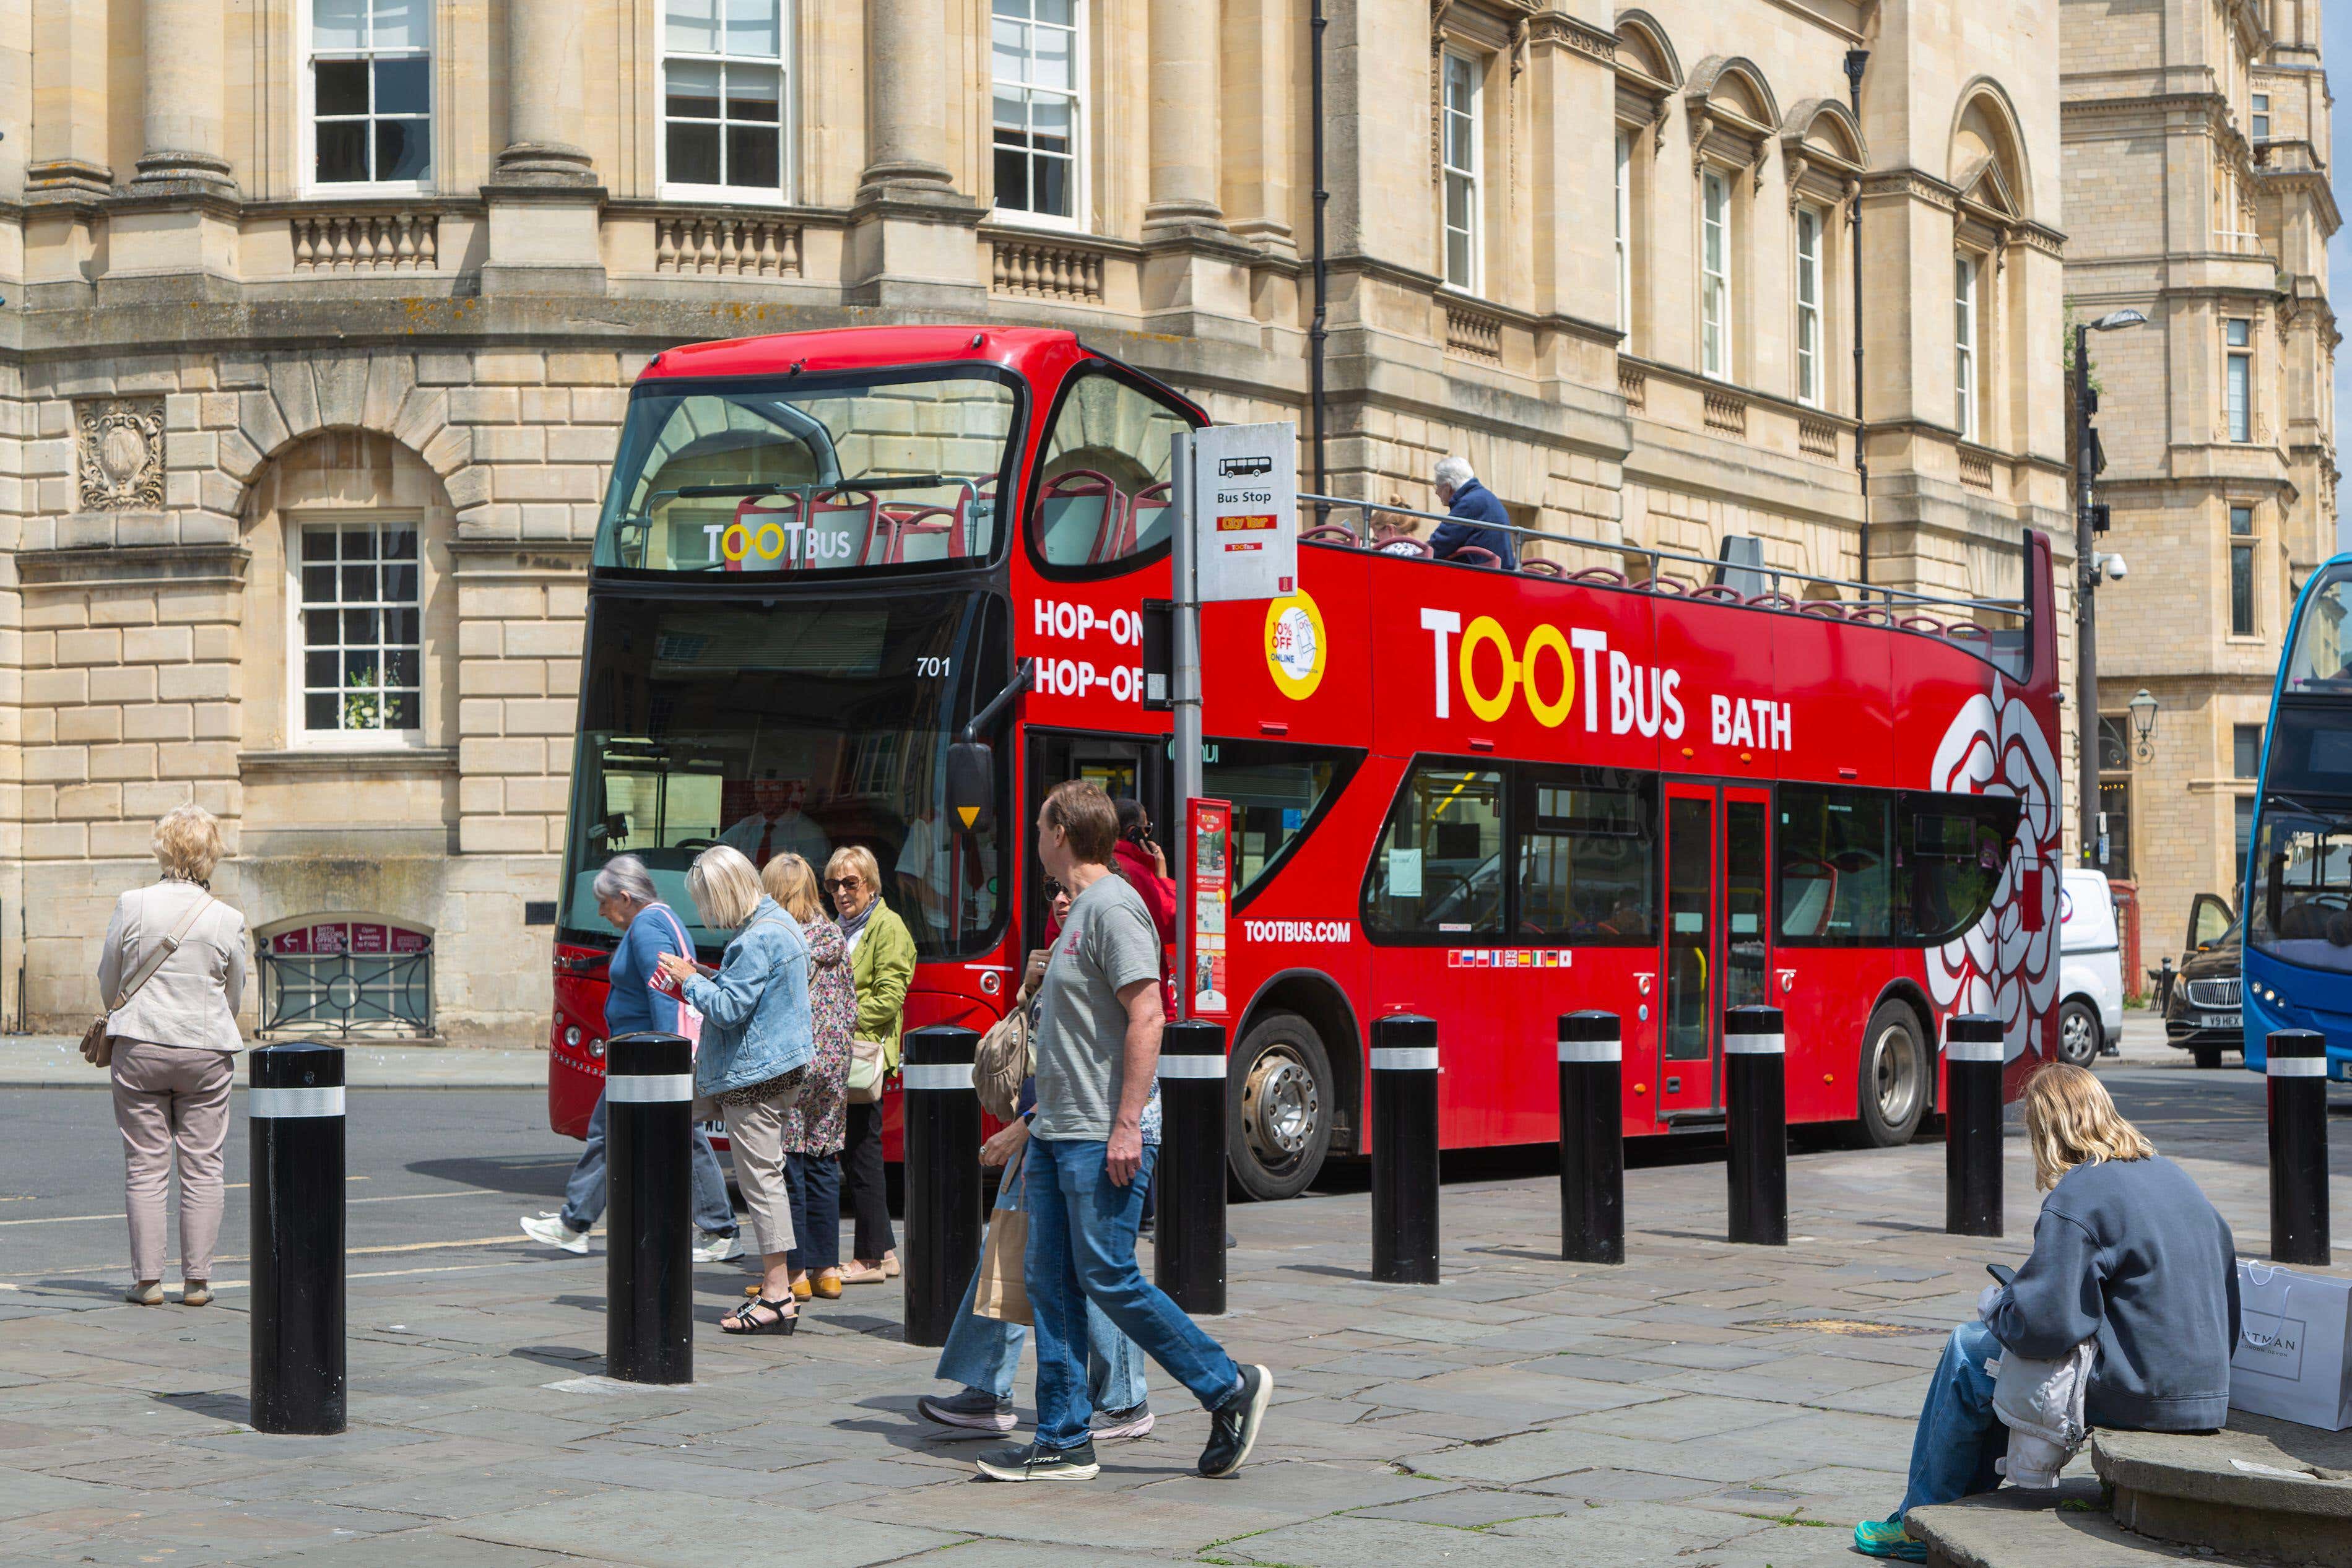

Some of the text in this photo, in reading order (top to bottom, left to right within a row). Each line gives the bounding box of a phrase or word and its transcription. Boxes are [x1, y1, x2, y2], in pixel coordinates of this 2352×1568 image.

[1218, 492, 1271, 504] Bus Stop
[1223, 515, 1268, 529] City Tour
[703, 522, 851, 561] TOOTBUS
[1273, 622, 1292, 636] 10%
[1272, 636, 1291, 649] OFF
[917, 657, 950, 677] 701
[1270, 653, 1295, 664] ONLINE
[1036, 657, 1143, 702] HOP-OF
[1421, 607, 1791, 752] TOOTBUS BATH
[1244, 920, 1350, 942] TOOTBUS.COM
